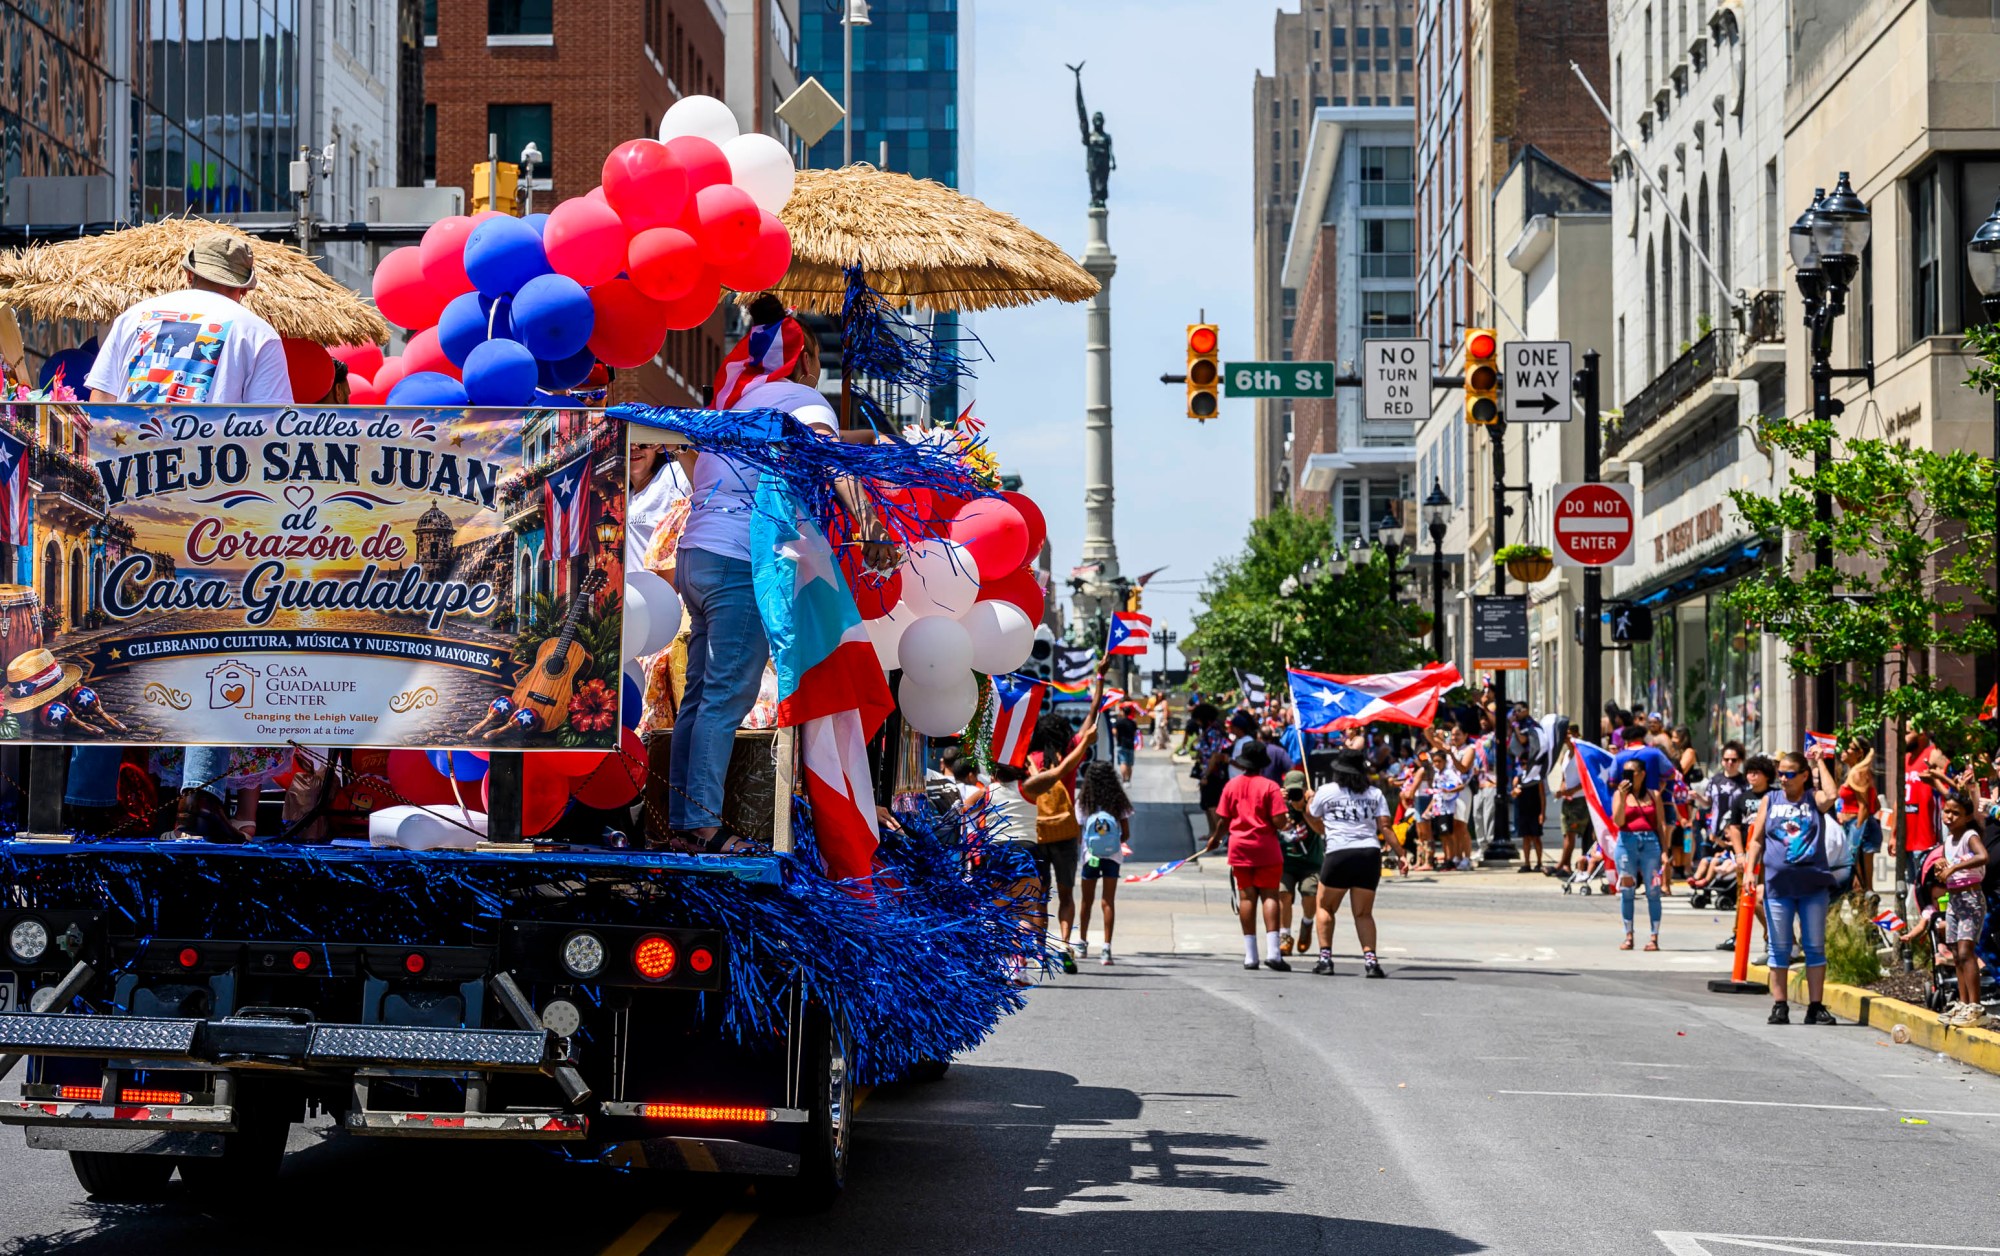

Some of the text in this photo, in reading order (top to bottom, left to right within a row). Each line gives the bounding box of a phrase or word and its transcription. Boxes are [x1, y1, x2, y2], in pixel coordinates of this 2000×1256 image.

[1381, 347, 1415, 364] NO
[1518, 349, 1558, 366] ONE
[1235, 370, 1323, 390] 6th St
[1378, 369, 1417, 381] TURN
[1516, 370, 1559, 388] WAY
[1387, 385, 1409, 398] ON
[1384, 402, 1413, 414] RED
[172, 410, 402, 441] De las Calles de
[95, 441, 503, 511] VIEJO SAN JUAN
[1565, 500, 1622, 513] DO NOT
[281, 505, 317, 530] al
[186, 517, 407, 564] Corazón de
[1571, 536, 1617, 549] ENTER
[103, 555, 496, 631] Casa Guadalupe
[128, 633, 490, 666] CELEBRANDO CULTURA, MÚSICA Y NUESTROS MAYORES
[244, 712, 379, 723] Changing the Lehigh Valley
[257, 725, 274, 734] One
[279, 726, 311, 736] person
[313, 725, 323, 735] at
[333, 726, 355, 735] time
